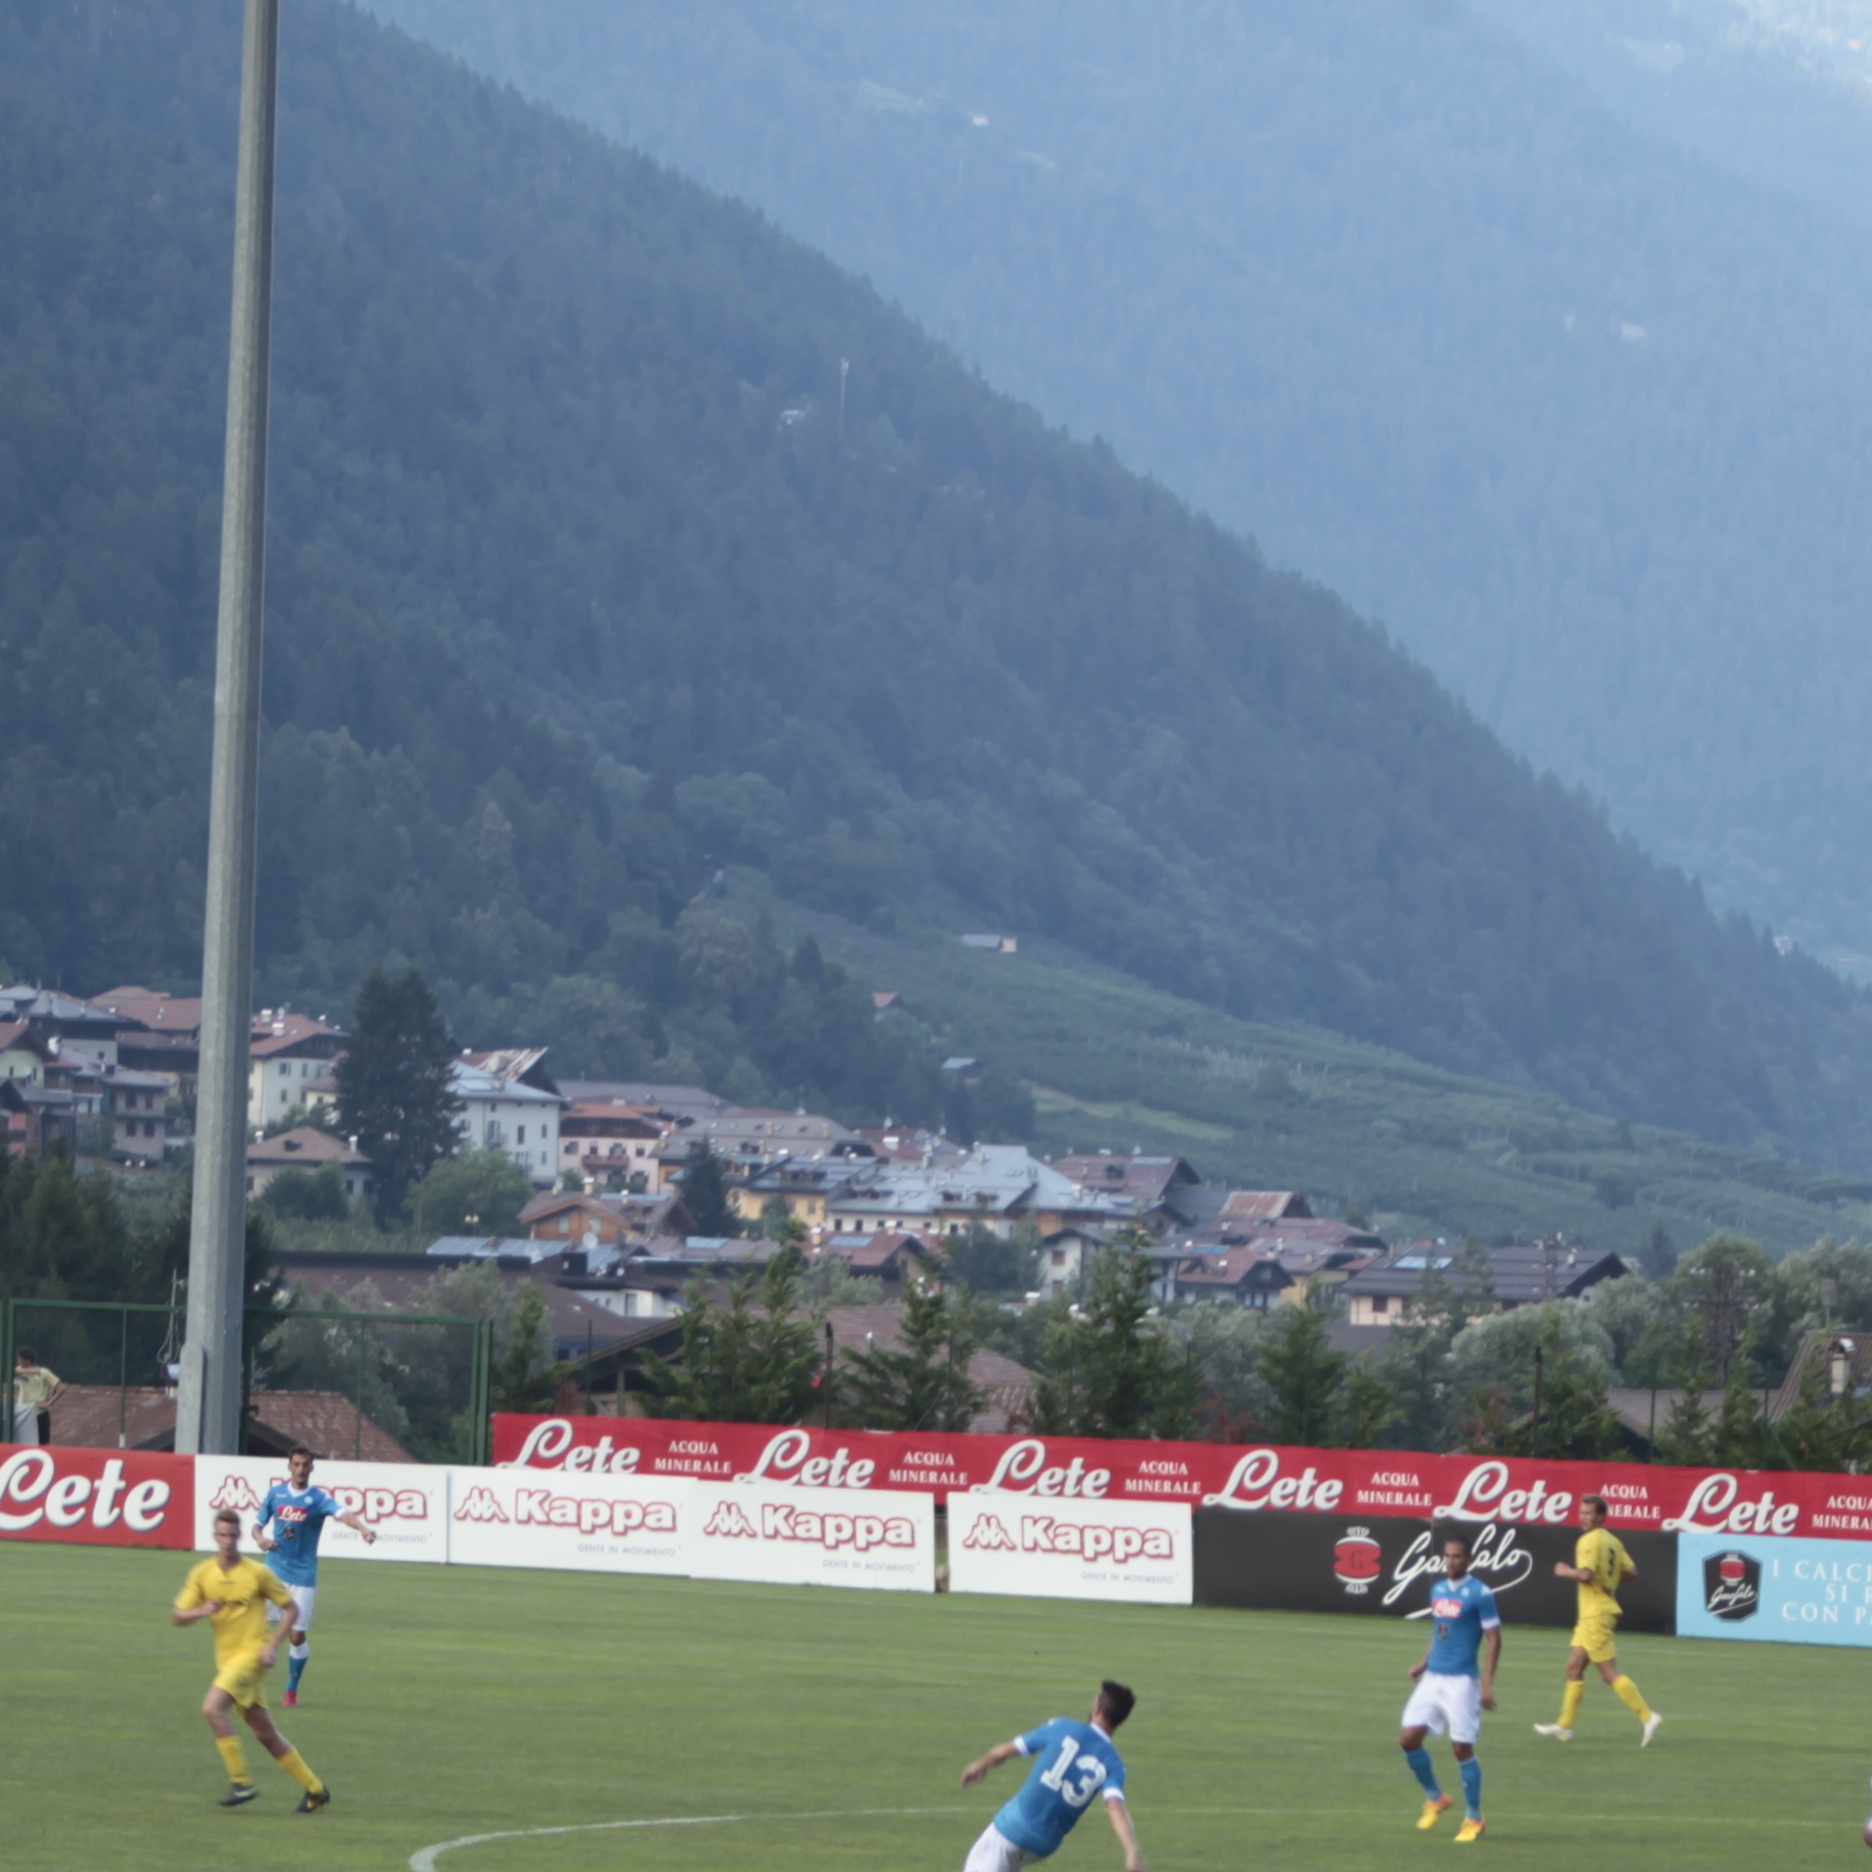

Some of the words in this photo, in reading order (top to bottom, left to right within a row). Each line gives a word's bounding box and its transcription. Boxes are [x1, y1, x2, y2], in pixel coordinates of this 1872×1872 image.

[495, 1418, 640, 1474] Lete
[668, 1440, 719, 1454] ACQUA
[654, 1458, 732, 1474] MINERALE
[733, 1429, 875, 1487] Lete
[903, 1451, 955, 1466] ACQUA
[969, 1439, 1111, 1498] Lete
[1139, 1460, 1188, 1475] ACQUA
[889, 1469, 968, 1485] MINERALE
[1202, 1449, 1344, 1510] Lete
[1371, 1472, 1420, 1486] ACQUA
[1125, 1479, 1201, 1495] MINERALE
[1433, 1461, 1573, 1523] Lete
[1600, 1484, 1648, 1499] ACQUA
[1357, 1490, 1432, 1506] MINERALE
[1662, 1473, 1800, 1534] Lete
[278, 1506, 308, 1522] Lete
[515, 1488, 677, 1537] Kappa
[1608, 1504, 1661, 1519] NERALE
[761, 1503, 916, 1551] Kappa
[1021, 1515, 1174, 1563] Kappa
[1825, 1584, 1847, 1602] SI
[1782, 1602, 1839, 1623] CON
[1040, 1735, 1107, 1807] 13
